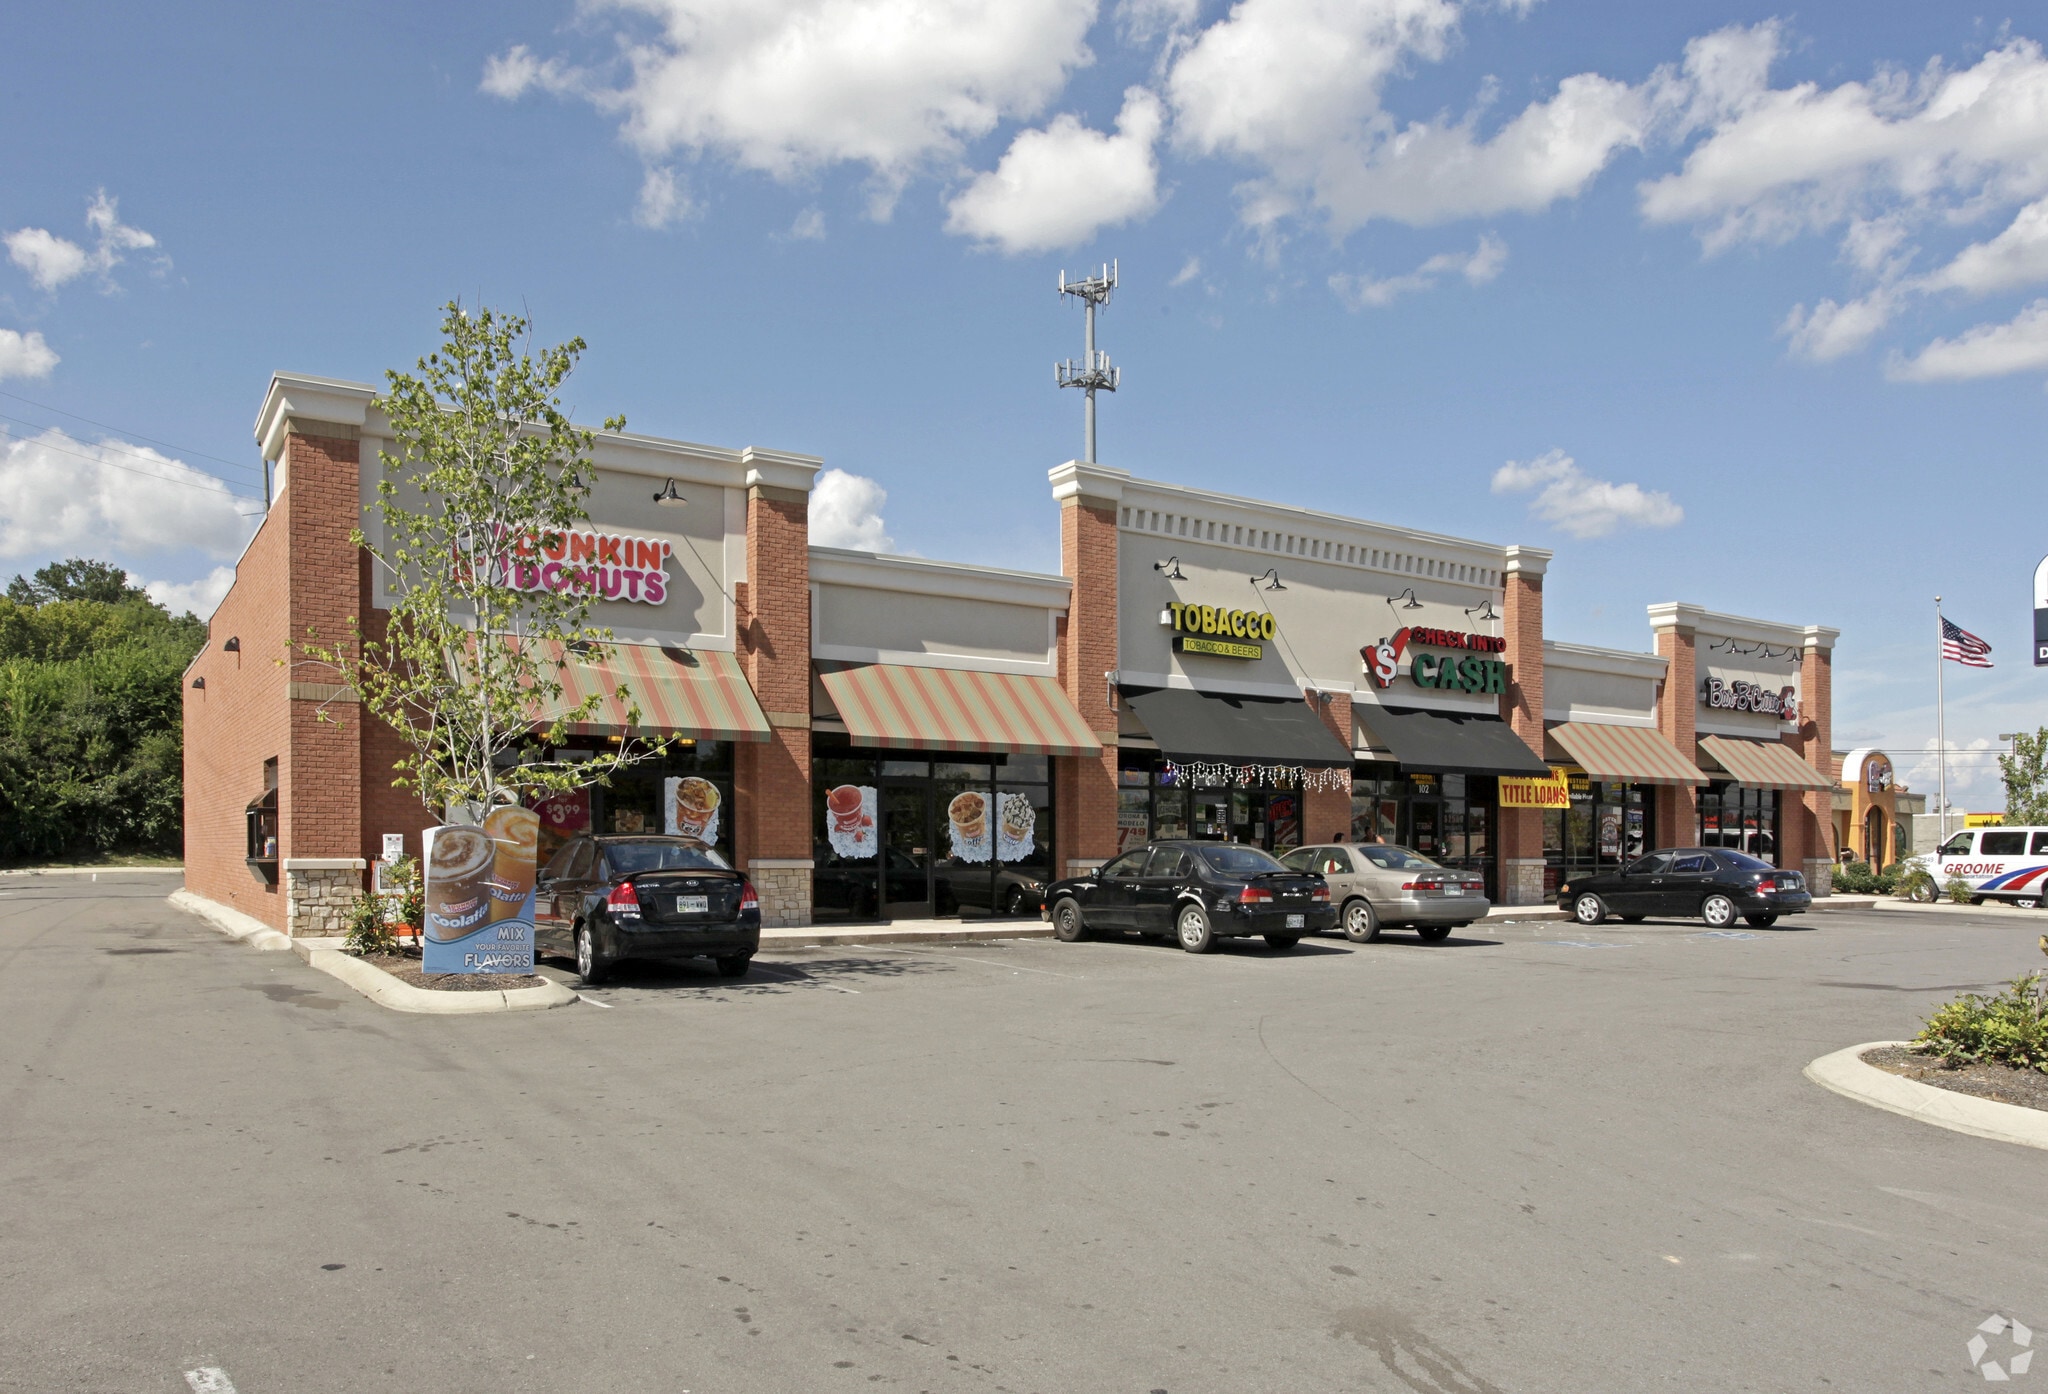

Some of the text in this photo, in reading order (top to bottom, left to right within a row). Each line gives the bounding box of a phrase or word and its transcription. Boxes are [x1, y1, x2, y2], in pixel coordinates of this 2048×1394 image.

[514, 526, 671, 571] DUNKIN'
[514, 561, 665, 602] DONUTS
[1170, 602, 1276, 640] TOBACCO
[1413, 626, 1468, 649] CHECK
[1471, 634, 1507, 652] INTO
[1186, 640, 1259, 657] TOBACCO & BEERS
[1418, 785, 1430, 793] 102
[1503, 785, 1567, 804] TITLE LOANS
[1944, 863, 2005, 874] GROOME
[430, 902, 488, 928] Coolatta
[498, 927, 525, 940] MIX
[498, 944, 530, 952] FAVORITE
[464, 953, 530, 967] FLAVORS
